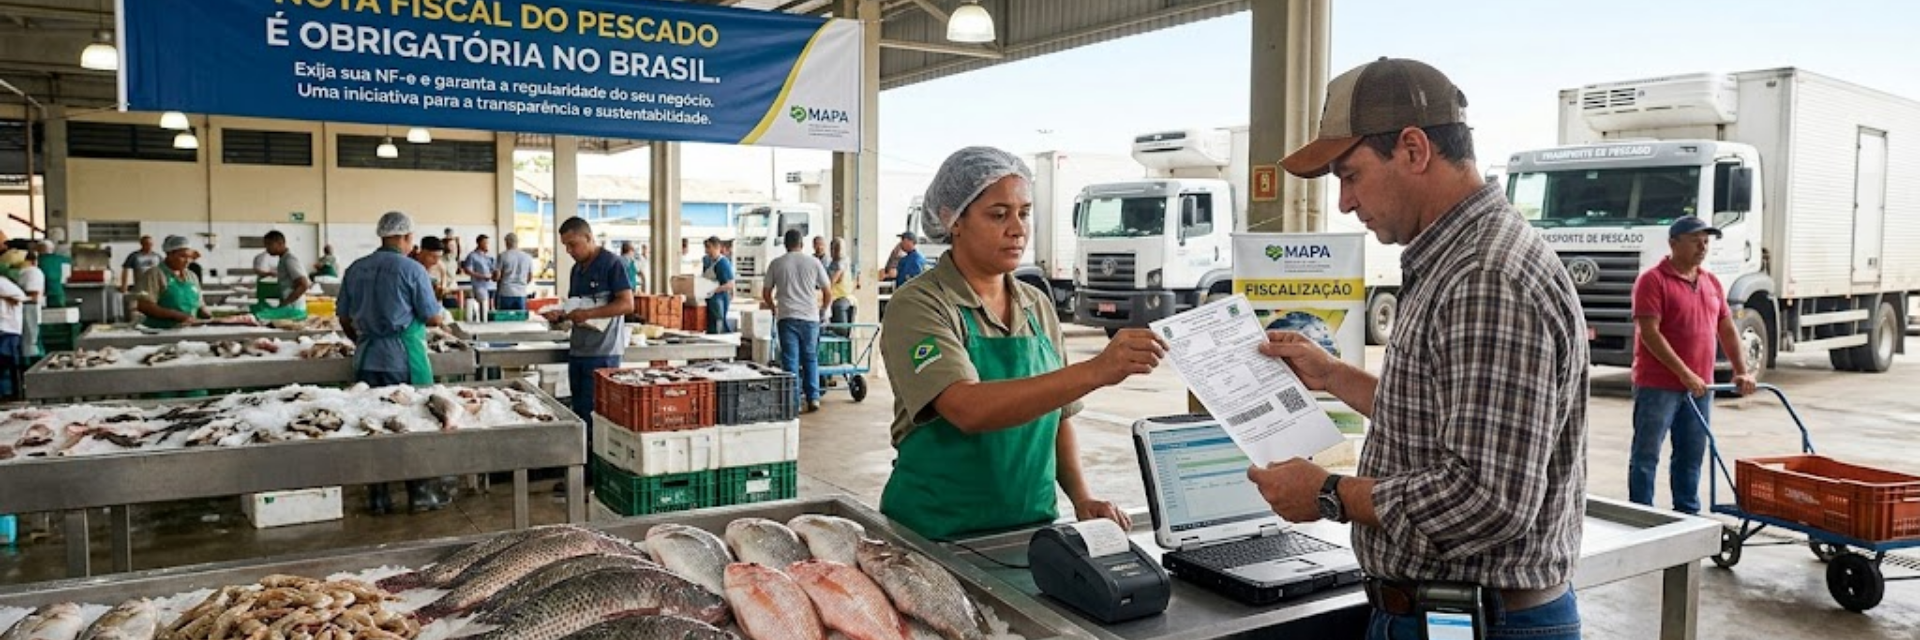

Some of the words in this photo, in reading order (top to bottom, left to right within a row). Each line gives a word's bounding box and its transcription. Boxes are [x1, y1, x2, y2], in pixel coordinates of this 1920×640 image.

[391, 0, 512, 27] FISCAL
[521, 4, 569, 33] DO
[578, 10, 719, 48] PESCADO
[266, 11, 289, 46] É
[299, 21, 545, 69] OBRIGATÓRIA
[553, 45, 601, 73] NO
[609, 50, 721, 84] BRASIL.
[294, 61, 337, 81] Exija
[340, 69, 371, 82] sua
[375, 69, 416, 85] NF-e
[420, 74, 431, 86] e
[434, 76, 496, 91] garanta
[500, 81, 509, 92] a
[513, 82, 607, 99] regularidade
[609, 87, 628, 101] do
[630, 91, 655, 103] seu
[658, 93, 714, 108] negócio.
[297, 83, 340, 99] Uma
[423, 94, 460, 109] para
[463, 97, 473, 109] a
[477, 97, 580, 116] transparência
[583, 105, 592, 117] e
[808, 107, 848, 123] MAPA
[1586, 233, 1598, 243] DE
[1600, 232, 1644, 243] PESCADO
[1284, 244, 1331, 259] MAPA
[1245, 280, 1353, 298] FISCALIZAÇÃO
